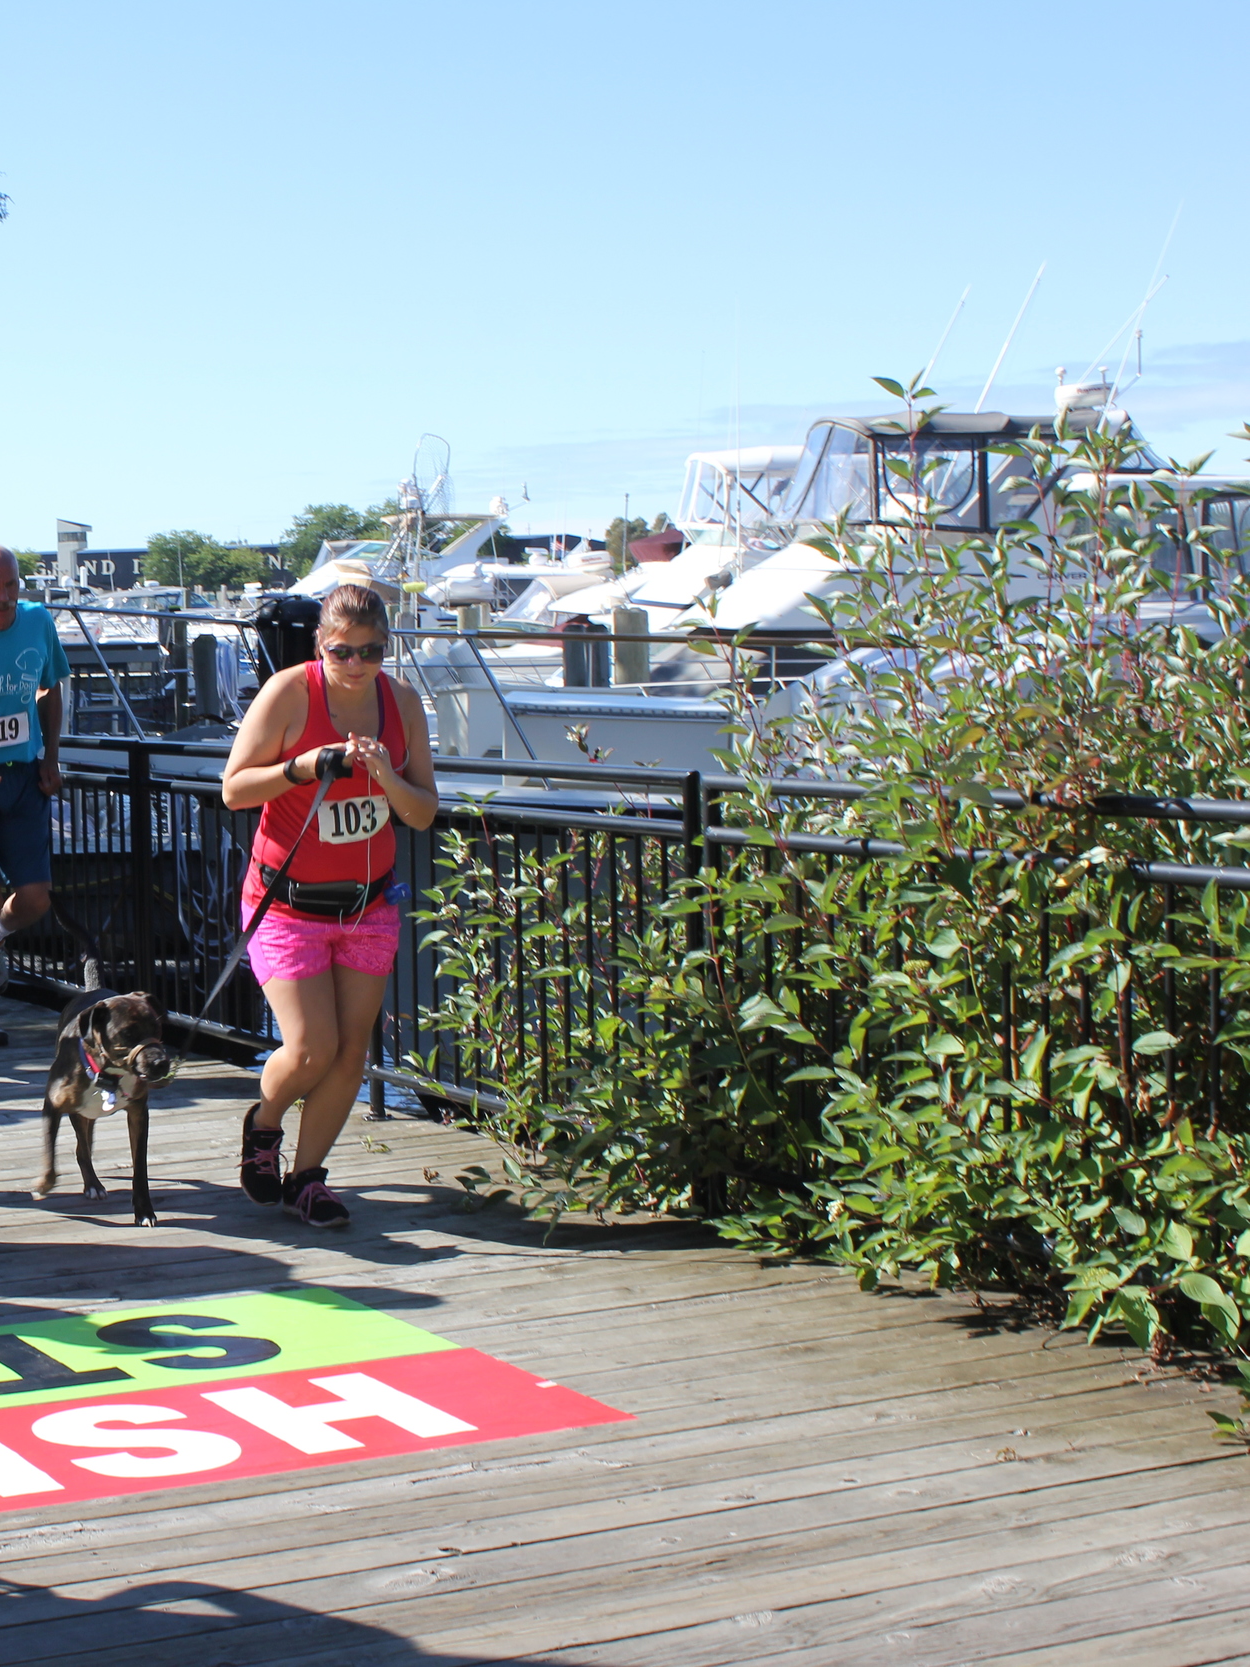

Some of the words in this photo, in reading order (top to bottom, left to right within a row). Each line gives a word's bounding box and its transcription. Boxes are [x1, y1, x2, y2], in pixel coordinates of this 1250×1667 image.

[33, 559, 116, 577] GRND
[6, 673, 18, 692] for
[329, 801, 378, 837] 103
